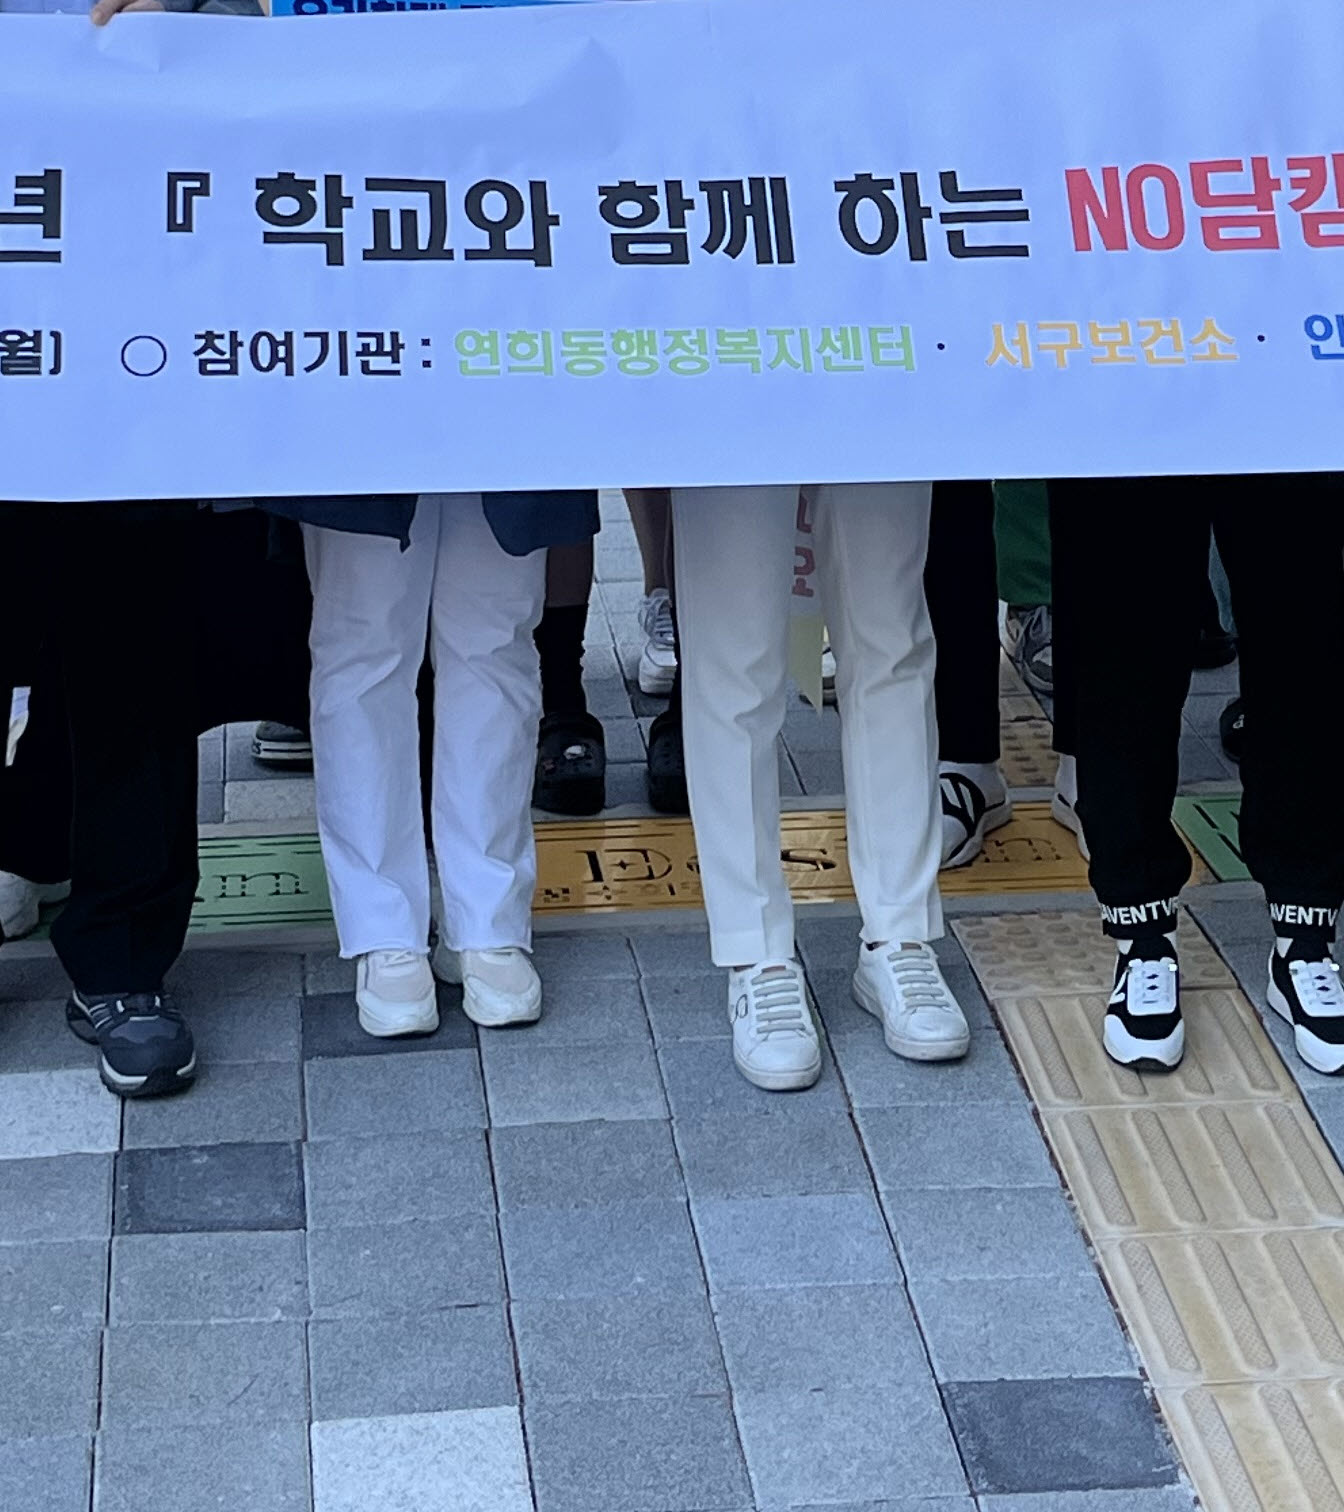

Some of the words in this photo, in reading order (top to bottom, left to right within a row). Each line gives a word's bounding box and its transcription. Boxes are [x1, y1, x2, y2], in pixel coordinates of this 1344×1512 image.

[256, 171, 558, 269] 학교와
[598, 174, 795, 267] 함께
[832, 169, 1031, 263] 하는
